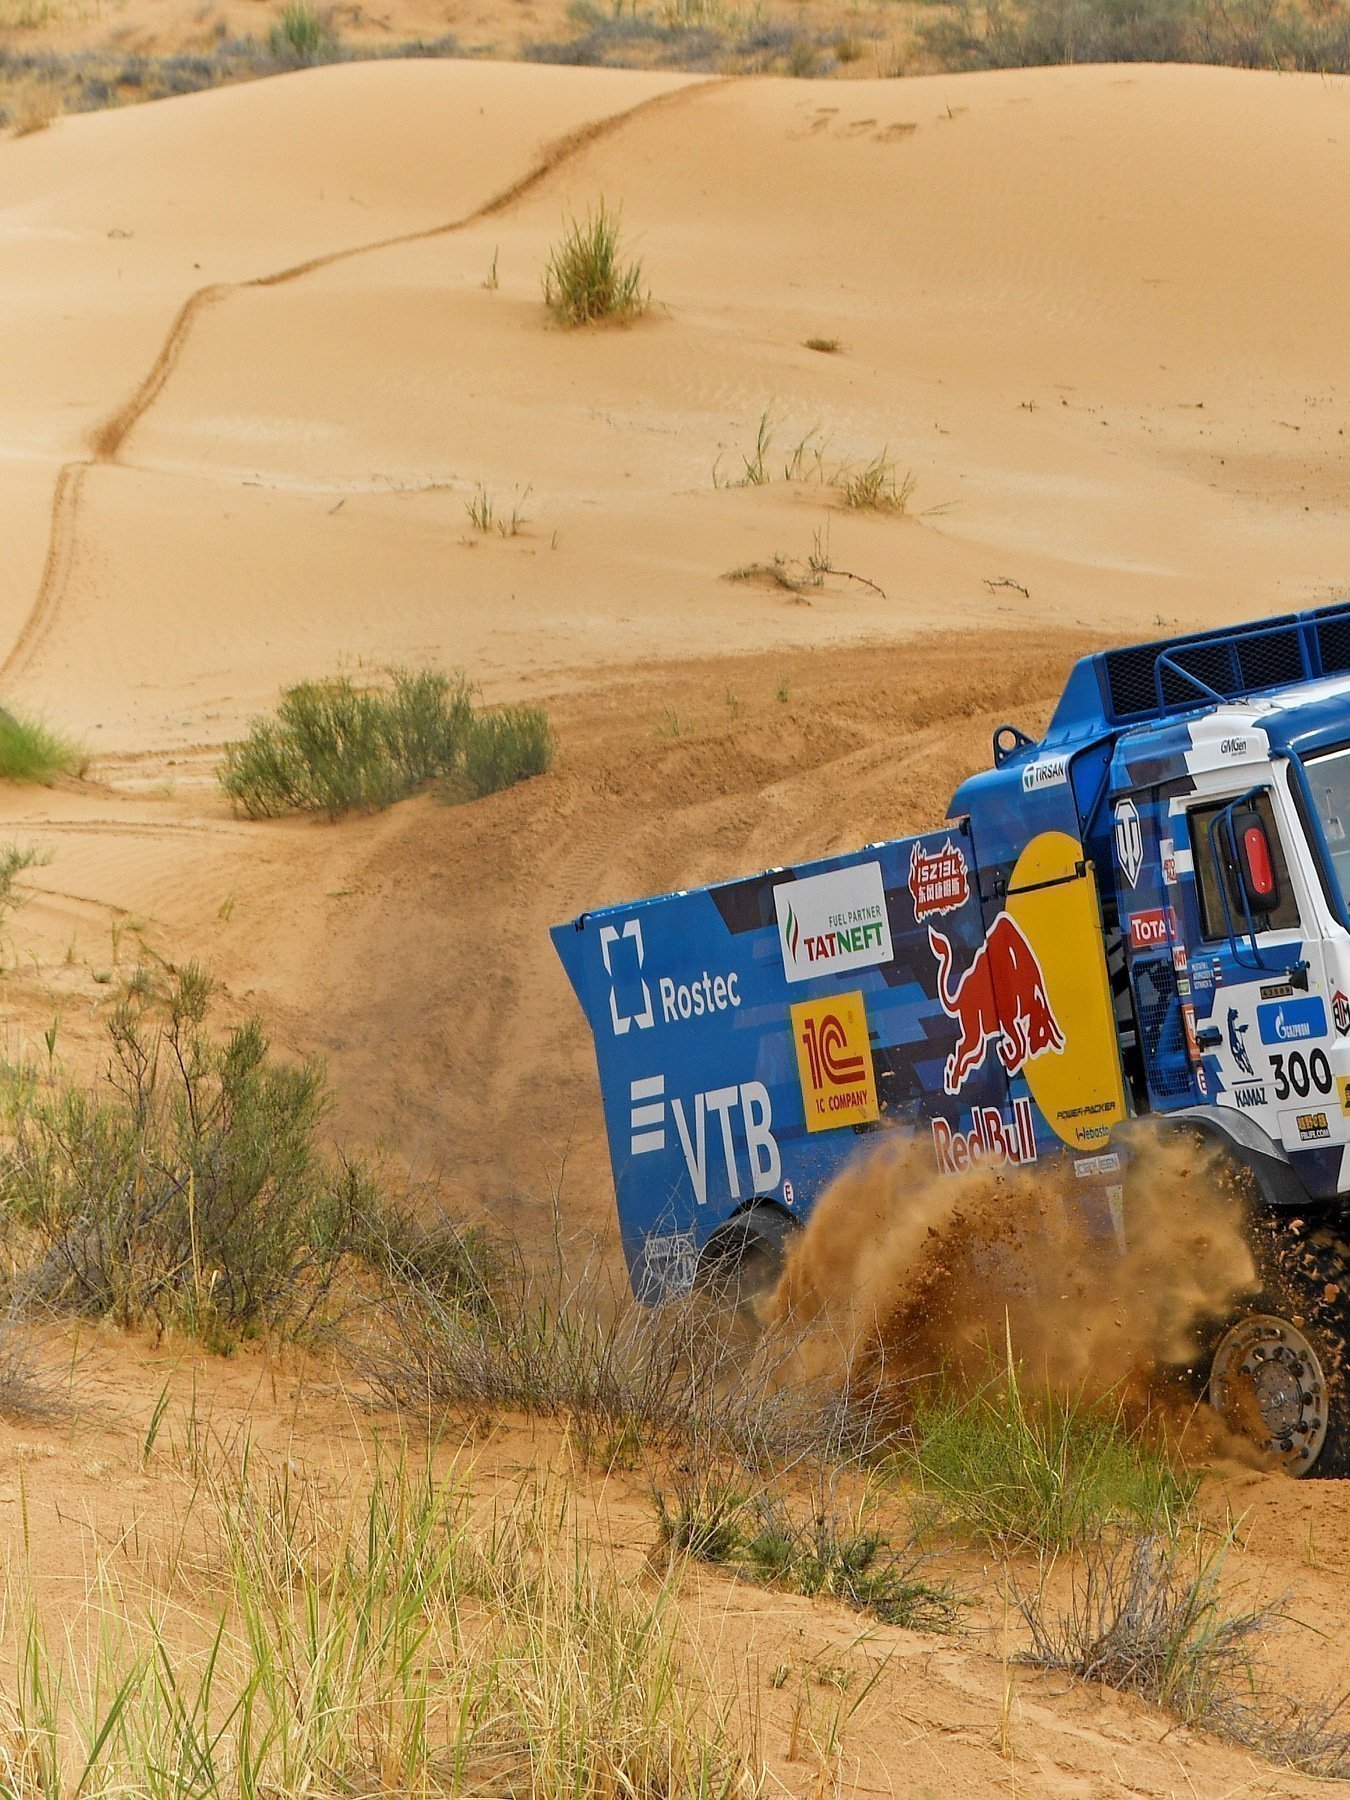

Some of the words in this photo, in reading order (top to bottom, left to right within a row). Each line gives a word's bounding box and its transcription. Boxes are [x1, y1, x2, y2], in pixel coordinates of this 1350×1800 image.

[1035, 760, 1064, 782] TIRSAN
[828, 915, 847, 928] FUEL
[848, 905, 882, 923] PARTNER
[1132, 917, 1175, 941] TOTAL
[803, 921, 884, 962] TATNEFT
[659, 971, 741, 1023] Rostec
[1268, 1047, 1333, 1101] 300
[828, 1090, 868, 1111] COMPANY
[1234, 1087, 1268, 1108] KAMAZ
[671, 1081, 782, 1206] VTB
